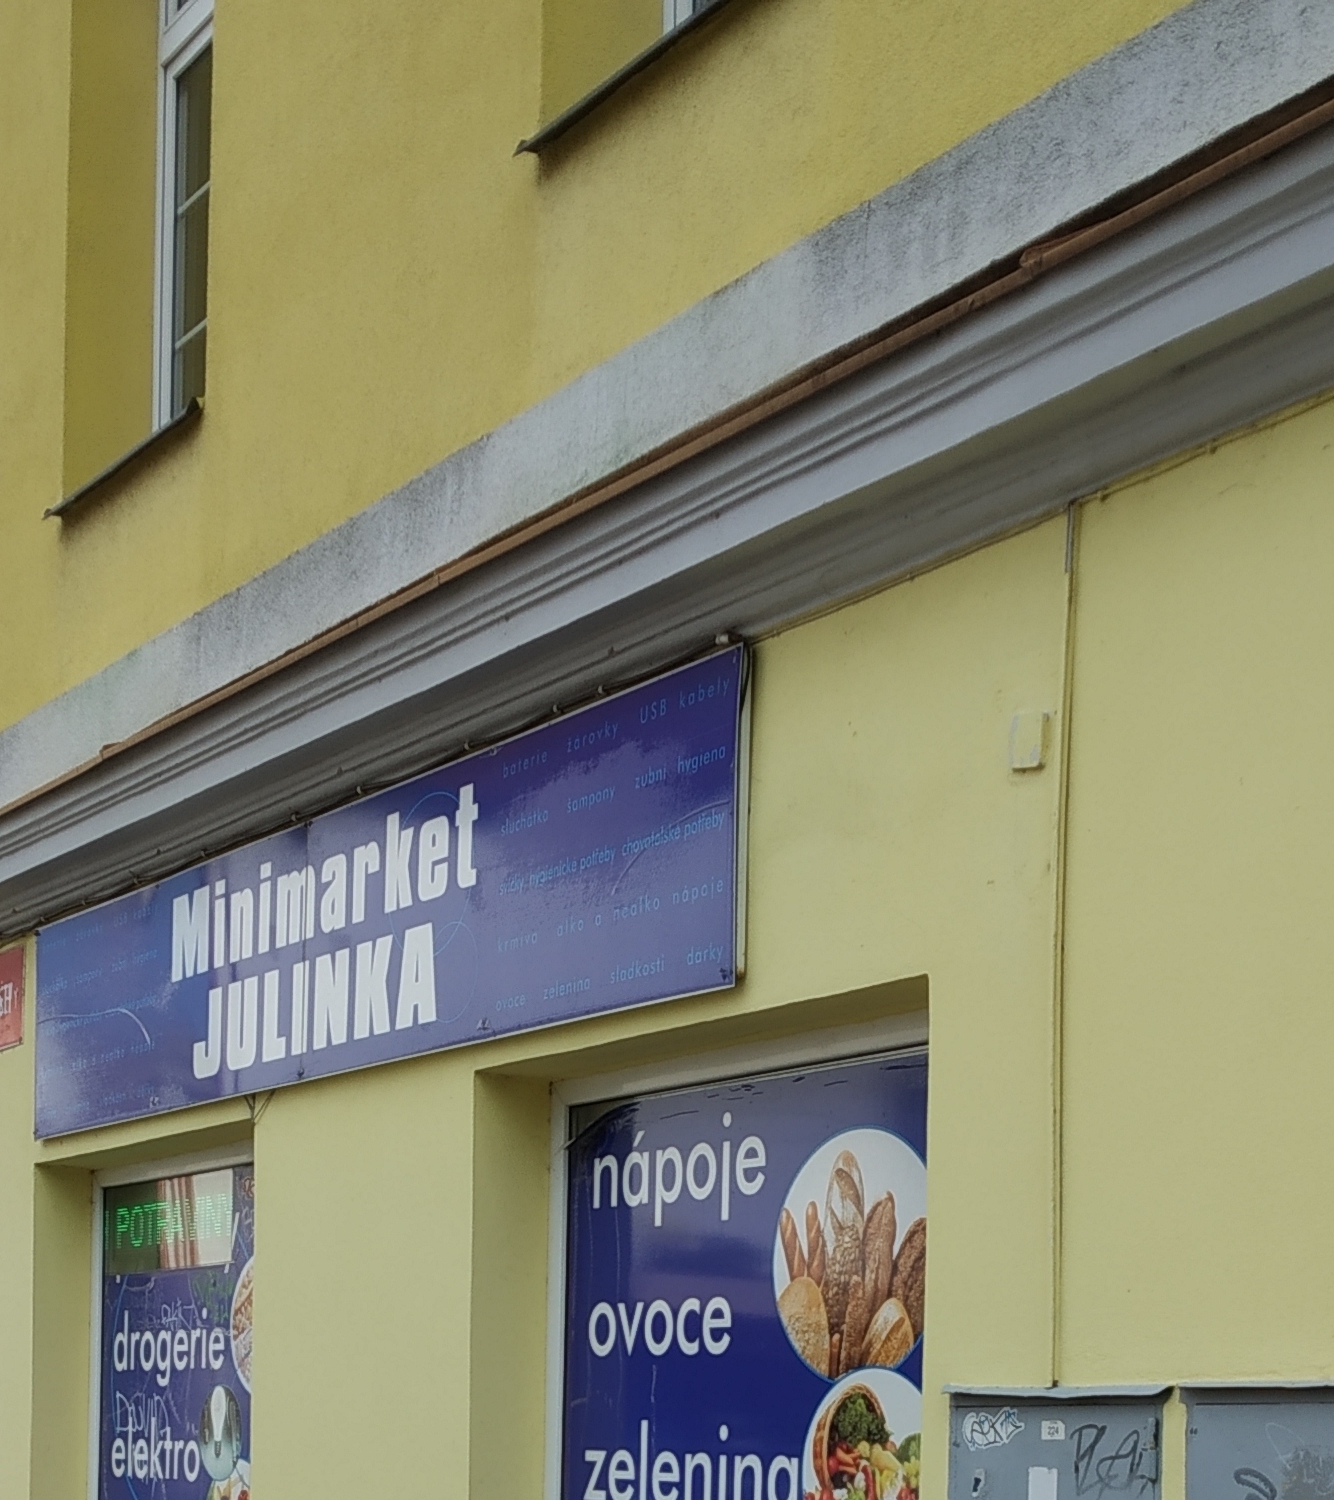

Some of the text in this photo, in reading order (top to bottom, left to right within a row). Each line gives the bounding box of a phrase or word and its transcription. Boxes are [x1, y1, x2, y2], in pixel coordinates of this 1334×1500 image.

[502, 675, 731, 779] baterie žárovky USB kabely
[677, 745, 727, 776] hygiena
[683, 808, 725, 842] potřeby
[170, 782, 479, 984] Minimarket
[613, 894, 660, 922] nealko
[672, 876, 724, 906] nápoje
[609, 956, 665, 985] sladkosti
[686, 944, 724, 970] dárky
[192, 921, 437, 1080] JULINKA
[591, 1111, 766, 1228] nápoje
[112, 1309, 226, 1387] drogerie
[587, 1296, 733, 1358] ovoce
[111, 1416, 201, 1484] elektro
